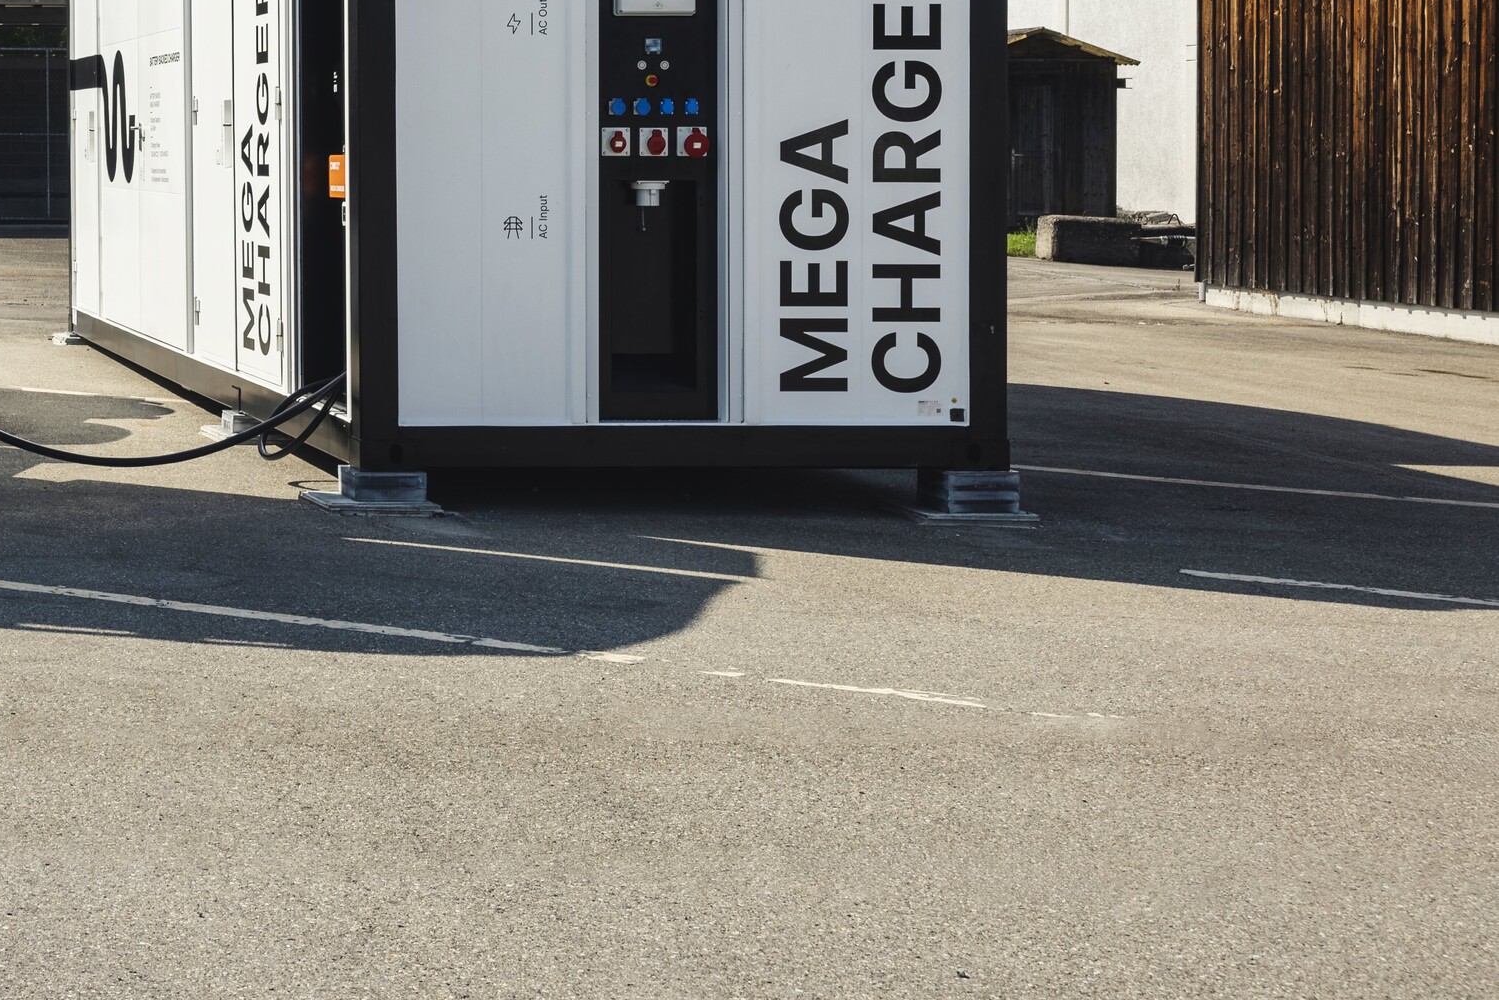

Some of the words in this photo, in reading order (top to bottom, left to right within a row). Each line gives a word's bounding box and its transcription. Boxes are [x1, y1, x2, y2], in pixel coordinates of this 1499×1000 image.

[538, 20, 548, 35] AC
[538, 195, 550, 221] Input
[241, 123, 256, 352] MEGA
[538, 224, 548, 239] AC
[779, 118, 849, 392] MEGA
